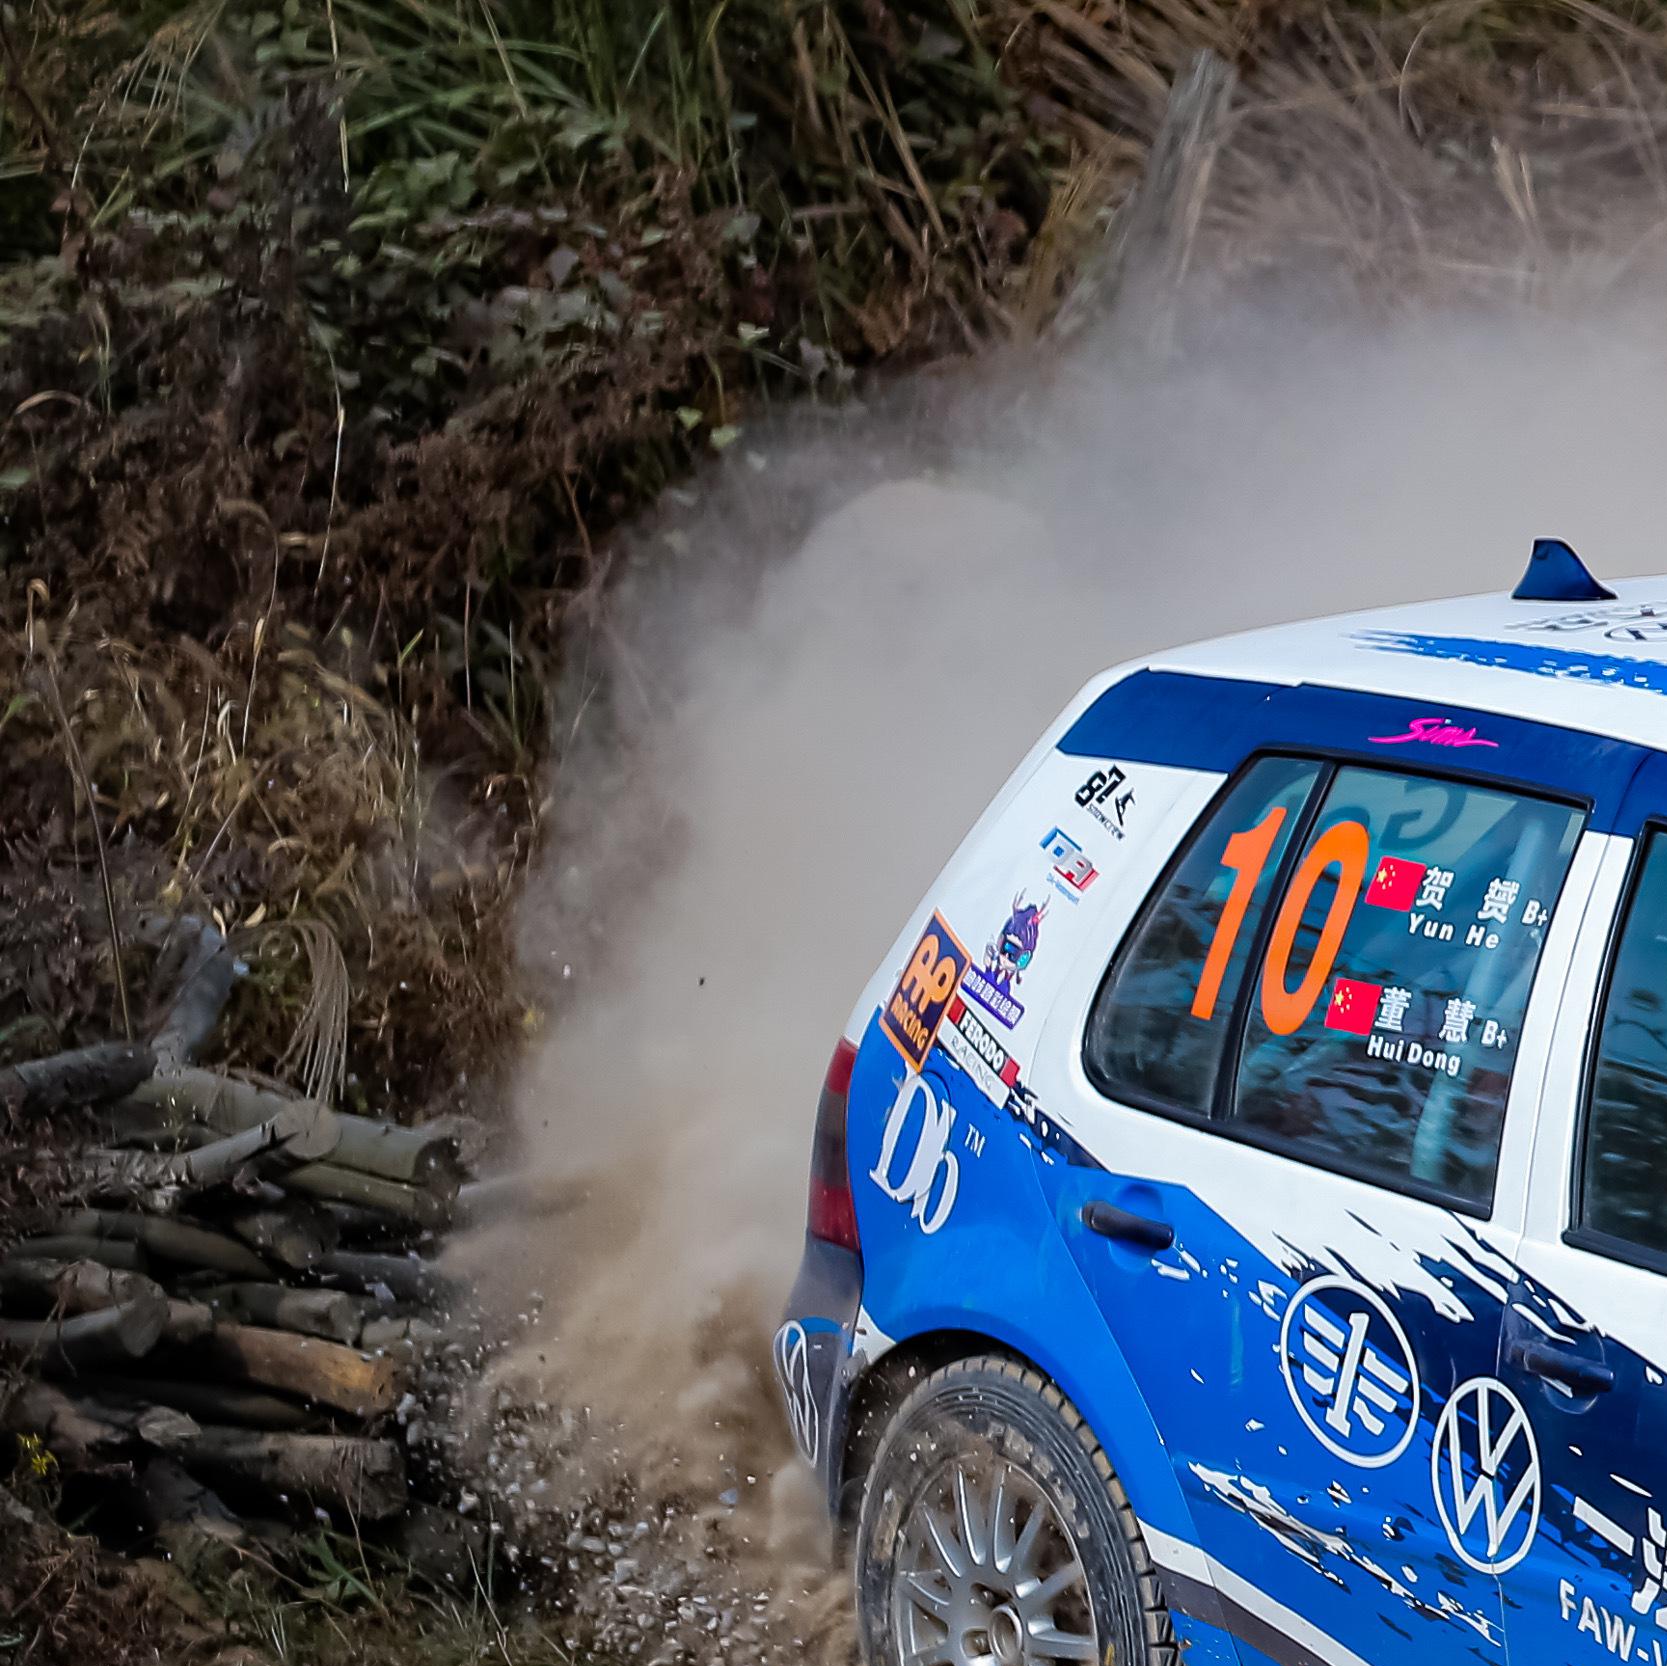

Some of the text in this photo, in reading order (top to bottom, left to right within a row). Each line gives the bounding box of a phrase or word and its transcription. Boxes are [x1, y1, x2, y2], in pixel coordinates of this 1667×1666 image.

[1191, 807, 1370, 1035] 10
[1408, 913, 1499, 949] Yun He
[1522, 900, 1549, 927] B+
[902, 934, 956, 1012] AP
[891, 993, 928, 1050] RACING
[960, 1010, 1004, 1072] FERODO
[1481, 1020, 1508, 1049] B+
[952, 1035, 995, 1090] RACING
[1367, 1034, 1461, 1076] Hui Dong
[964, 1123, 986, 1158] TM
